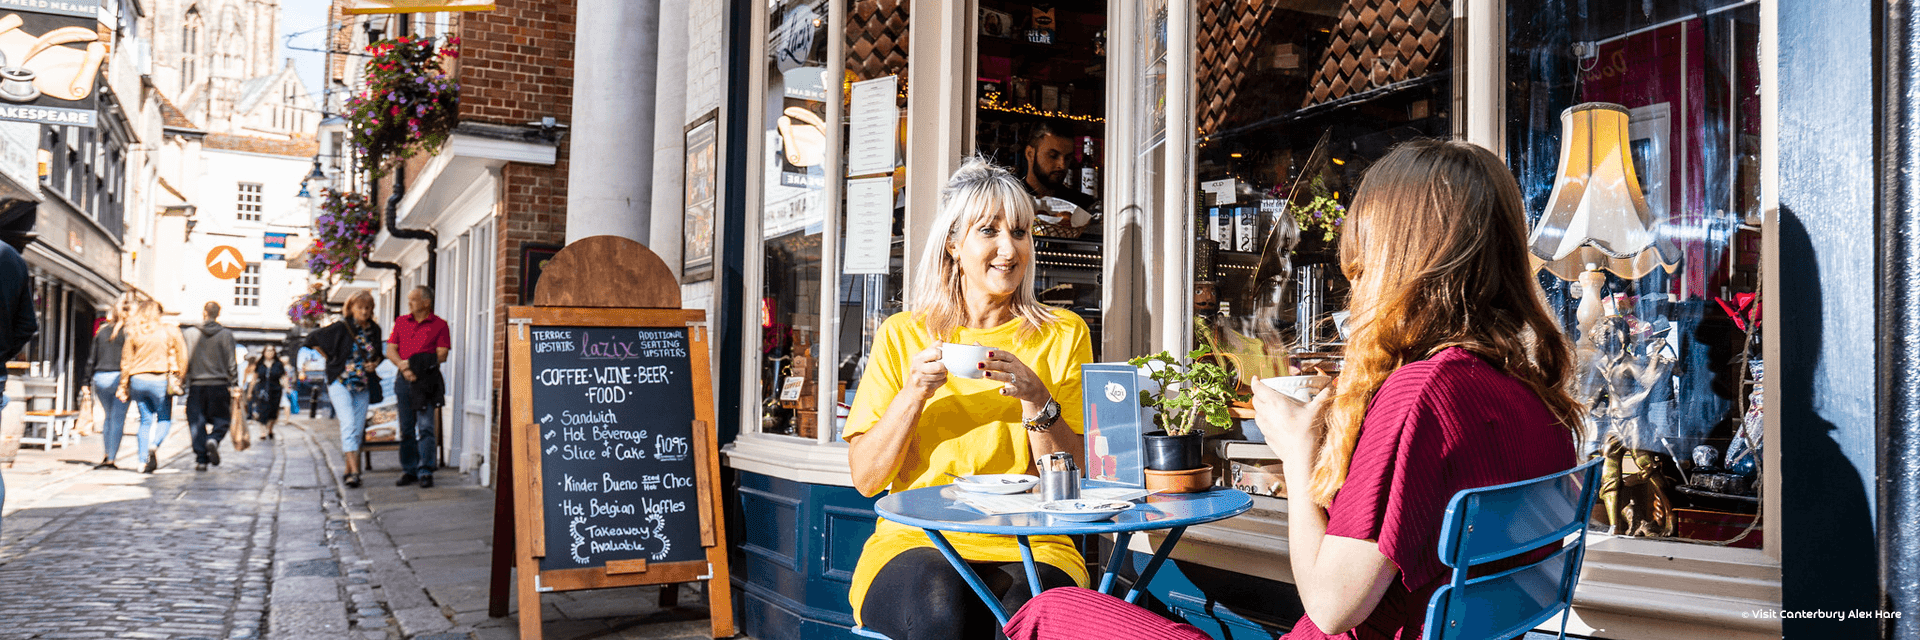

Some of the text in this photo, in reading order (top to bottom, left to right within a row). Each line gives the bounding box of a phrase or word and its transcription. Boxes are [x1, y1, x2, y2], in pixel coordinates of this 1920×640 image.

[50, 2, 97, 14] NEAME
[0, 106, 89, 124] AKESPEARE
[532, 331, 572, 341] TERRACE
[638, 330, 684, 341] ADDITIONAL
[640, 339, 680, 349] SEATING
[535, 341, 575, 353] UPSTAIRS
[643, 348, 687, 358] UPSTAIRS
[541, 365, 669, 386] COFFEE WINE BEER
[589, 386, 626, 403] FOOD
[560, 409, 618, 426] Sandwich
[563, 427, 586, 442] Hot
[593, 427, 648, 445] Beverage
[562, 444, 596, 461] Slice
[601, 448, 612, 460] of
[615, 443, 646, 461] Cake
[563, 471, 638, 494] Kinder Bueno
[663, 472, 693, 489] Choc
[563, 496, 686, 518] Hot Belgian Waffles
[585, 524, 650, 539] Takeaway
